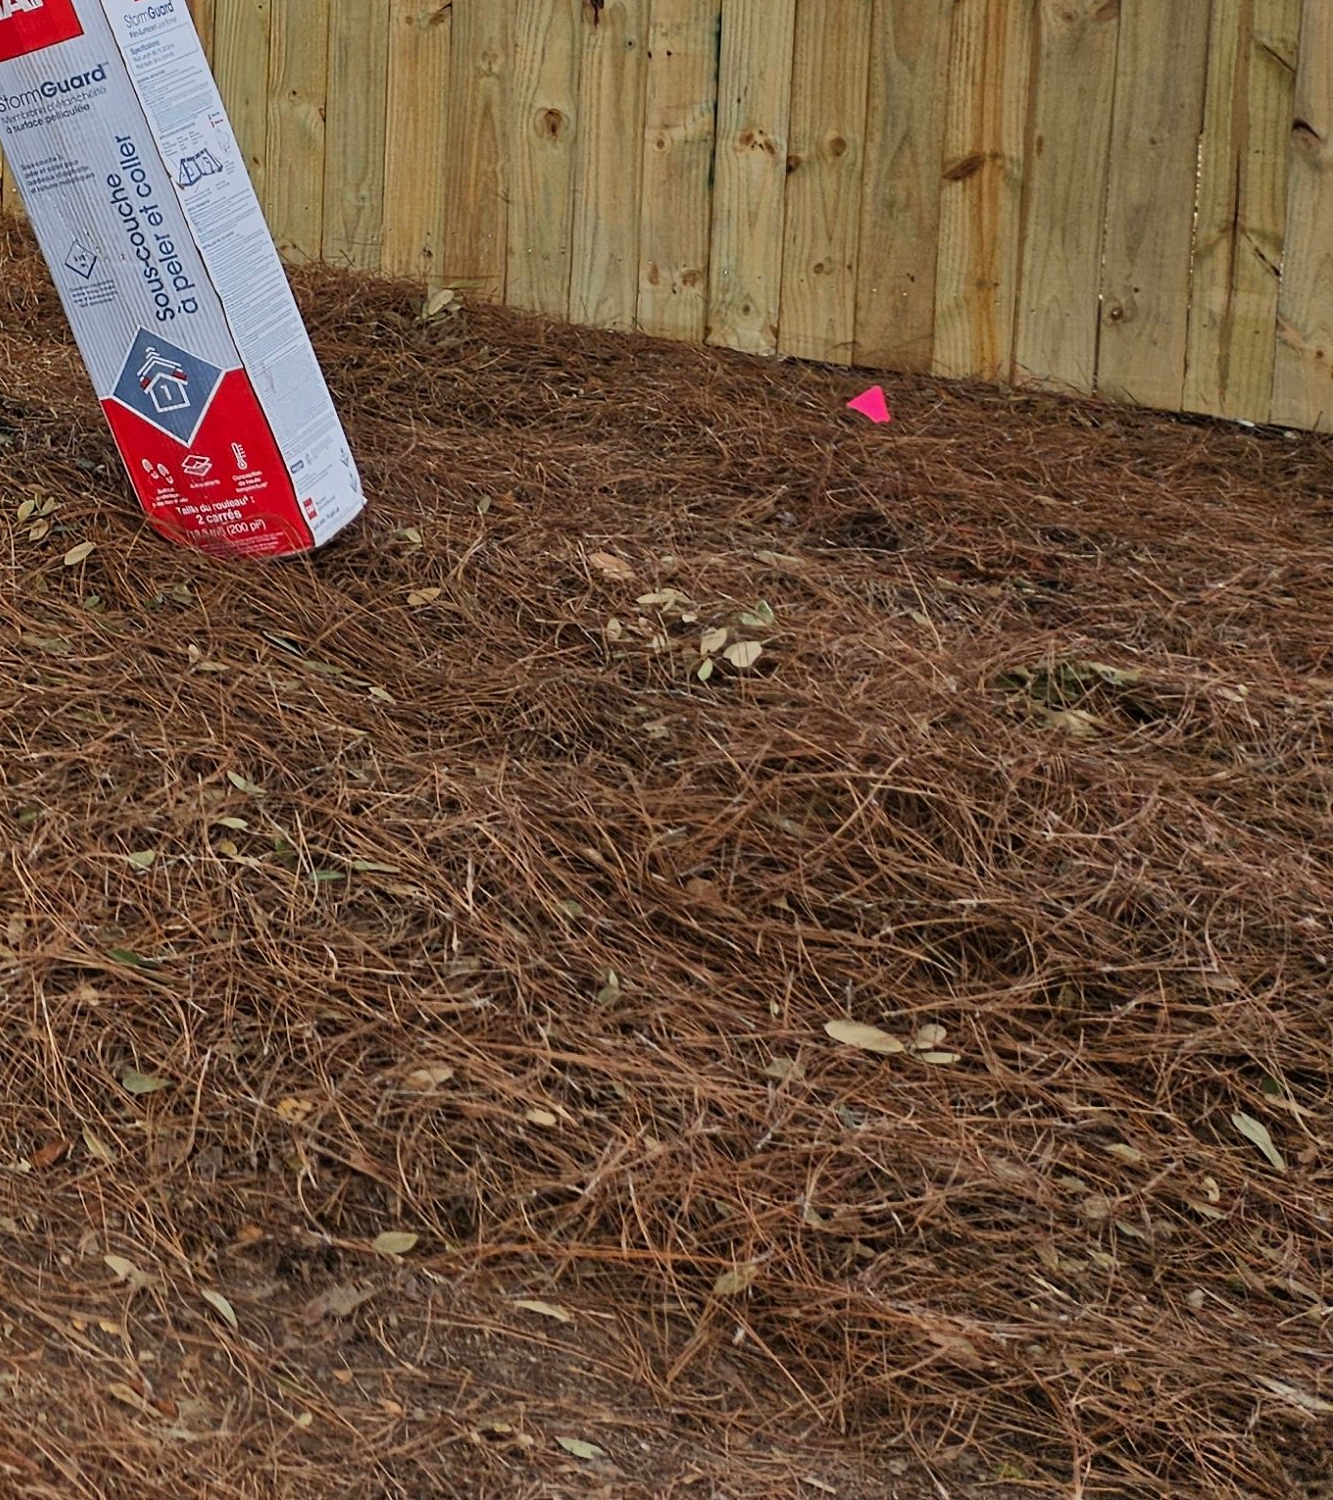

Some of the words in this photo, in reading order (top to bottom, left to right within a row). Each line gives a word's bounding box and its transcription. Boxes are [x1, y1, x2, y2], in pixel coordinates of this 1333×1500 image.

[115, 135, 152, 198] coller
[139, 204, 163, 227] et
[106, 173, 175, 322] Sous-couche
[153, 234, 196, 292] peler
[177, 296, 199, 314] à
[196, 514, 205, 525] 2
[206, 509, 242, 523] carrés
[226, 521, 249, 537] (200
